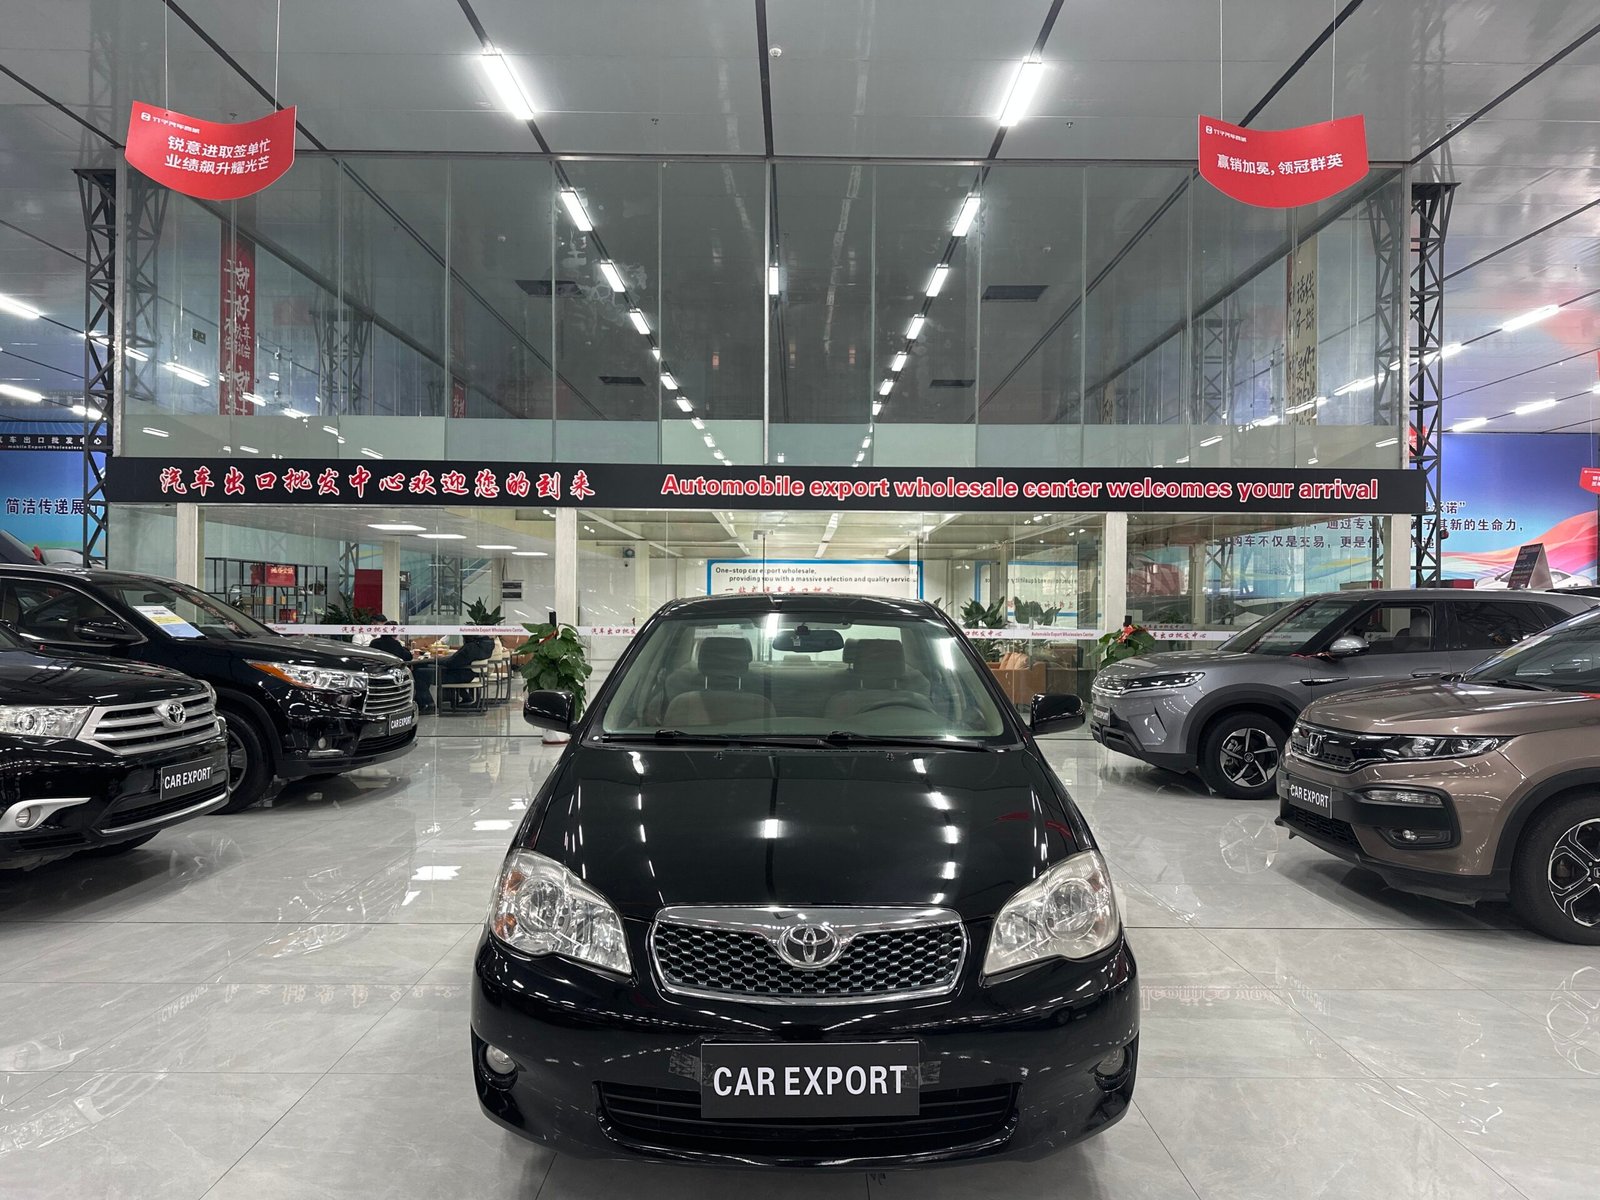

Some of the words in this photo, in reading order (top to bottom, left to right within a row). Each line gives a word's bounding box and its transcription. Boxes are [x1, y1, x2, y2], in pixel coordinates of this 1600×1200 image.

[167, 135, 271, 158] 锐意进取签单忙
[164, 153, 270, 175] 业绩飙升耀光芒
[159, 465, 596, 500] 汽车出口批发中心欢迎您的到来
[661, 473, 805, 497] Automobile
[809, 477, 889, 501] export
[894, 476, 1018, 498] wholesale
[1023, 478, 1102, 498] center
[1106, 477, 1232, 499] welcomes
[1237, 479, 1294, 503] your
[1298, 478, 1379, 500] arrival
[715, 567, 747, 575] One-stop
[759, 567, 780, 576] eport
[782, 567, 816, 575] wholesale,
[729, 575, 760, 583] providing
[796, 575, 822, 583] massive
[823, 575, 852, 583] selection
[853, 575, 866, 583] and
[867, 576, 889, 584] quality
[164, 773, 182, 790] CAR
[182, 766, 212, 786] EXPORT
[1289, 783, 1303, 797] CAR
[1303, 789, 1329, 809] EXPORT
[713, 1066, 775, 1096] CAR
[784, 1065, 908, 1095] EXPORT
